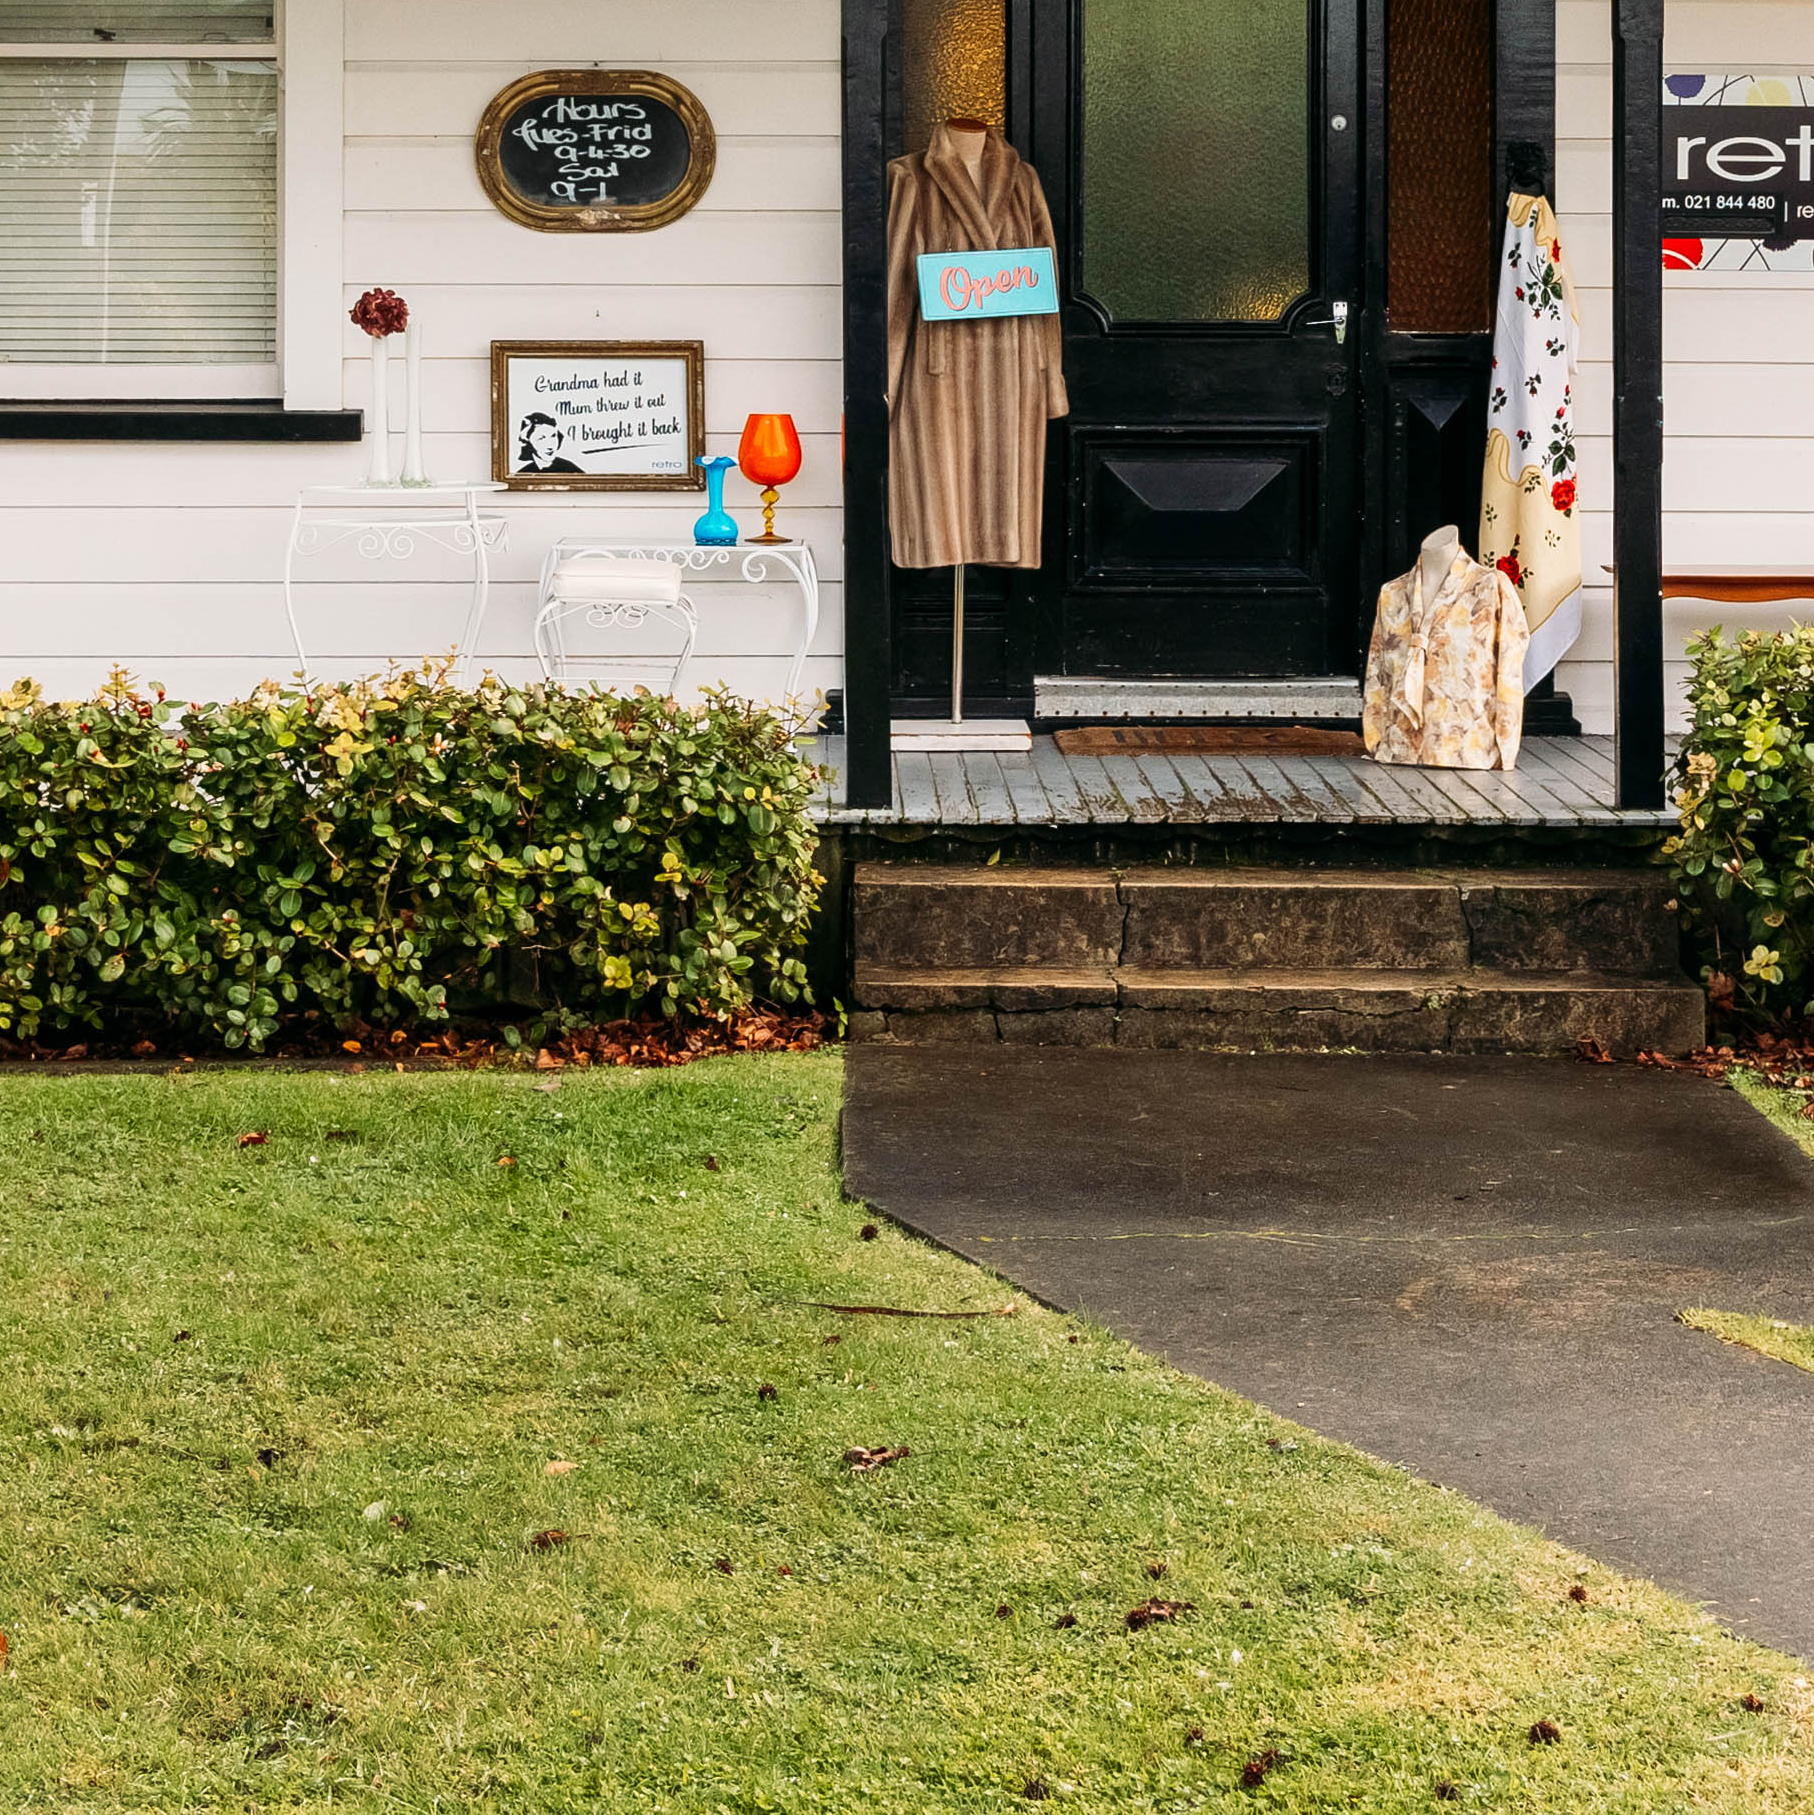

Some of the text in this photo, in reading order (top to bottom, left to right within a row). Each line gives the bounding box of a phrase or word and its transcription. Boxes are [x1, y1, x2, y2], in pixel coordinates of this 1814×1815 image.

[542, 97, 646, 123] Hours
[558, 162, 620, 181] Sat
[1684, 195, 1711, 209] 021
[1715, 195, 1744, 210] 844
[1747, 195, 1776, 210] 480
[940, 265, 1038, 311] Open
[534, 370, 643, 393] Grandma had it
[555, 393, 666, 416] Mum threw it out
[567, 416, 681, 444] I brought it back
[651, 460, 683, 469] retro
